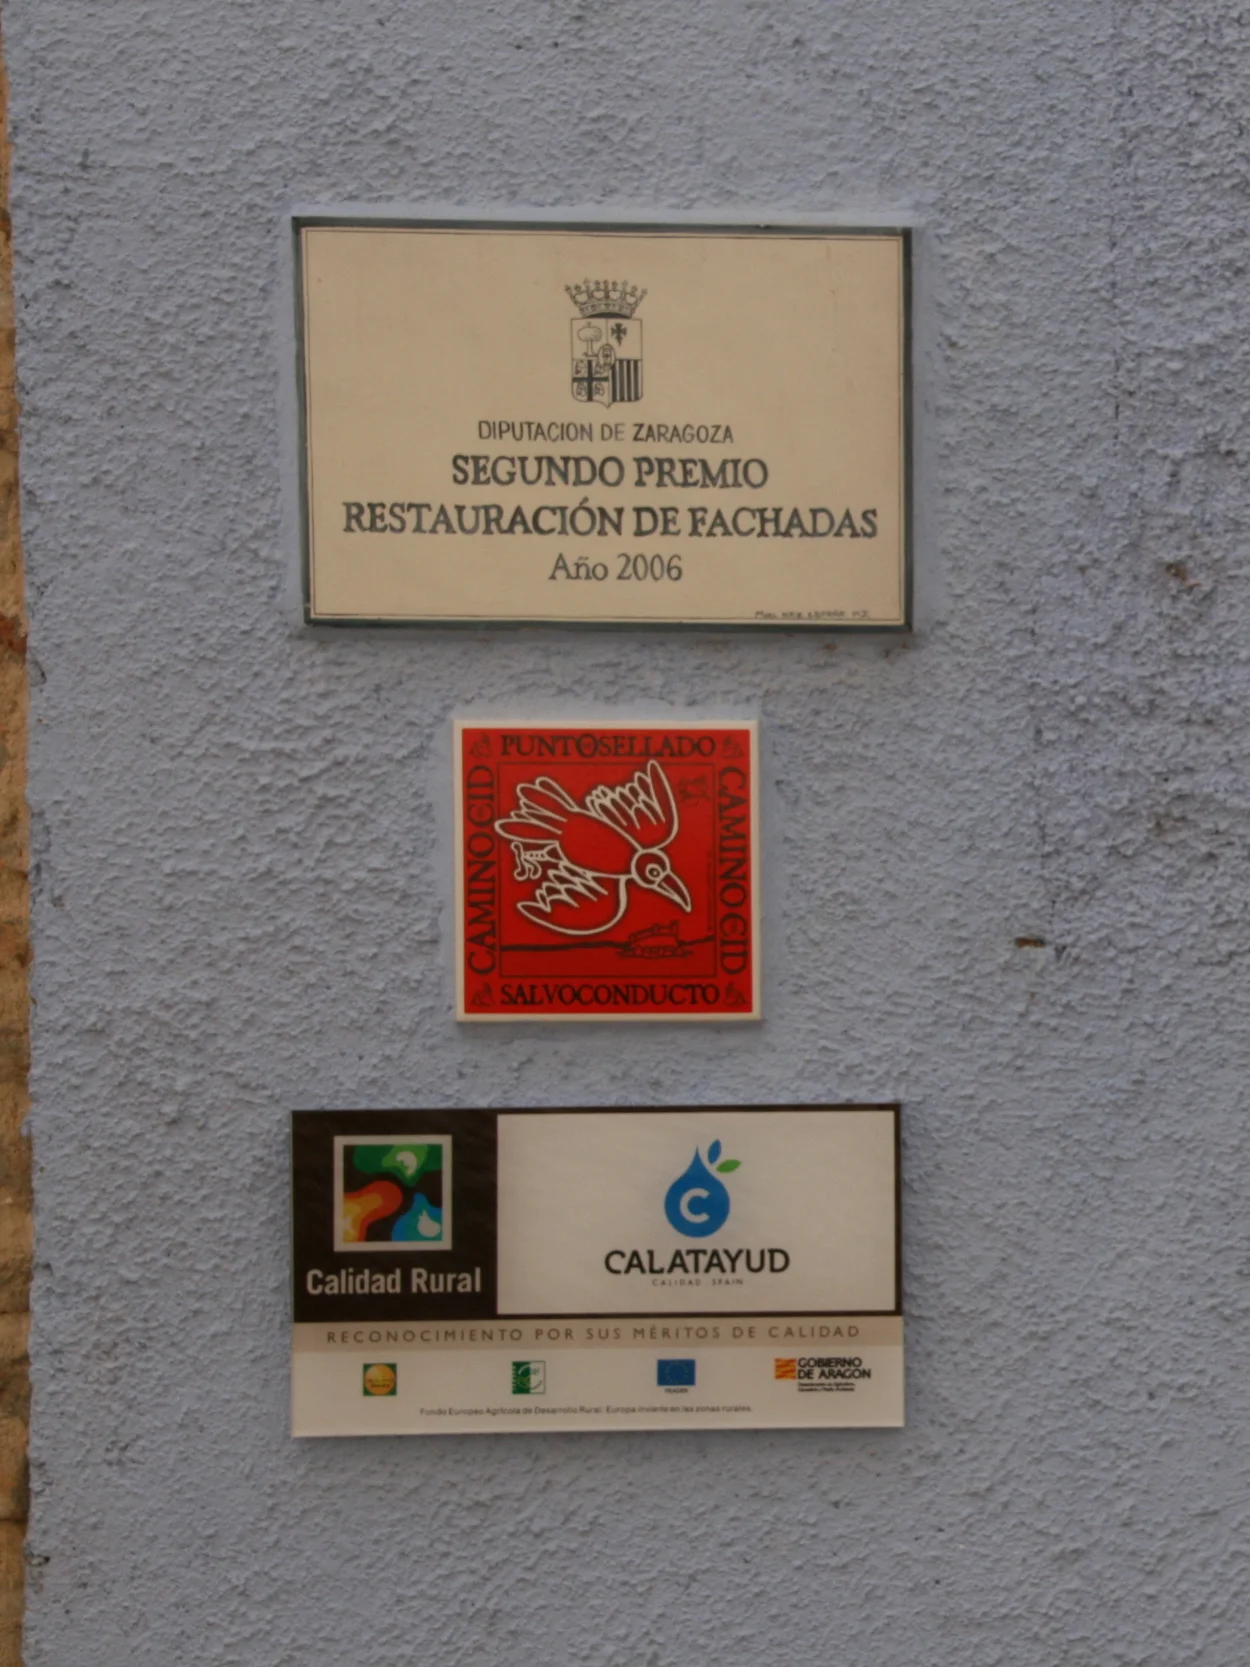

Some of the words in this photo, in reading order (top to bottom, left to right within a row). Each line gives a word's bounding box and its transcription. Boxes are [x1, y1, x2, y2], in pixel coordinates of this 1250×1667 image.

[477, 419, 594, 443] DIPUTACION
[600, 422, 626, 442] DE
[632, 422, 734, 444] ZARAGOZA
[451, 454, 625, 488] SEGUNDO
[633, 456, 769, 490] PREMIO
[342, 496, 625, 537] RESTAURACIÓN
[632, 506, 682, 538] DE
[688, 506, 879, 540] FACHADAS
[548, 553, 609, 582] Año
[616, 553, 684, 582] 2006
[500, 983, 721, 1006] SALVOCONDUCTO
[604, 1248, 791, 1275] CALATAYUD
[306, 1268, 402, 1296] Calidad
[411, 1266, 482, 1294] Rural
[651, 1278, 702, 1288] CALIDAD
[711, 1277, 744, 1287] SPAIN
[327, 1328, 523, 1343] RECONOCIMIENTO
[535, 1328, 575, 1342] POR
[586, 1327, 622, 1341] SUS
[633, 1323, 722, 1340] MÉRITOS
[732, 1326, 756, 1339] DE
[768, 1325, 860, 1339] CALIDAD
[798, 1357, 862, 1368] GOBIERNO
[798, 1368, 814, 1379] DE
